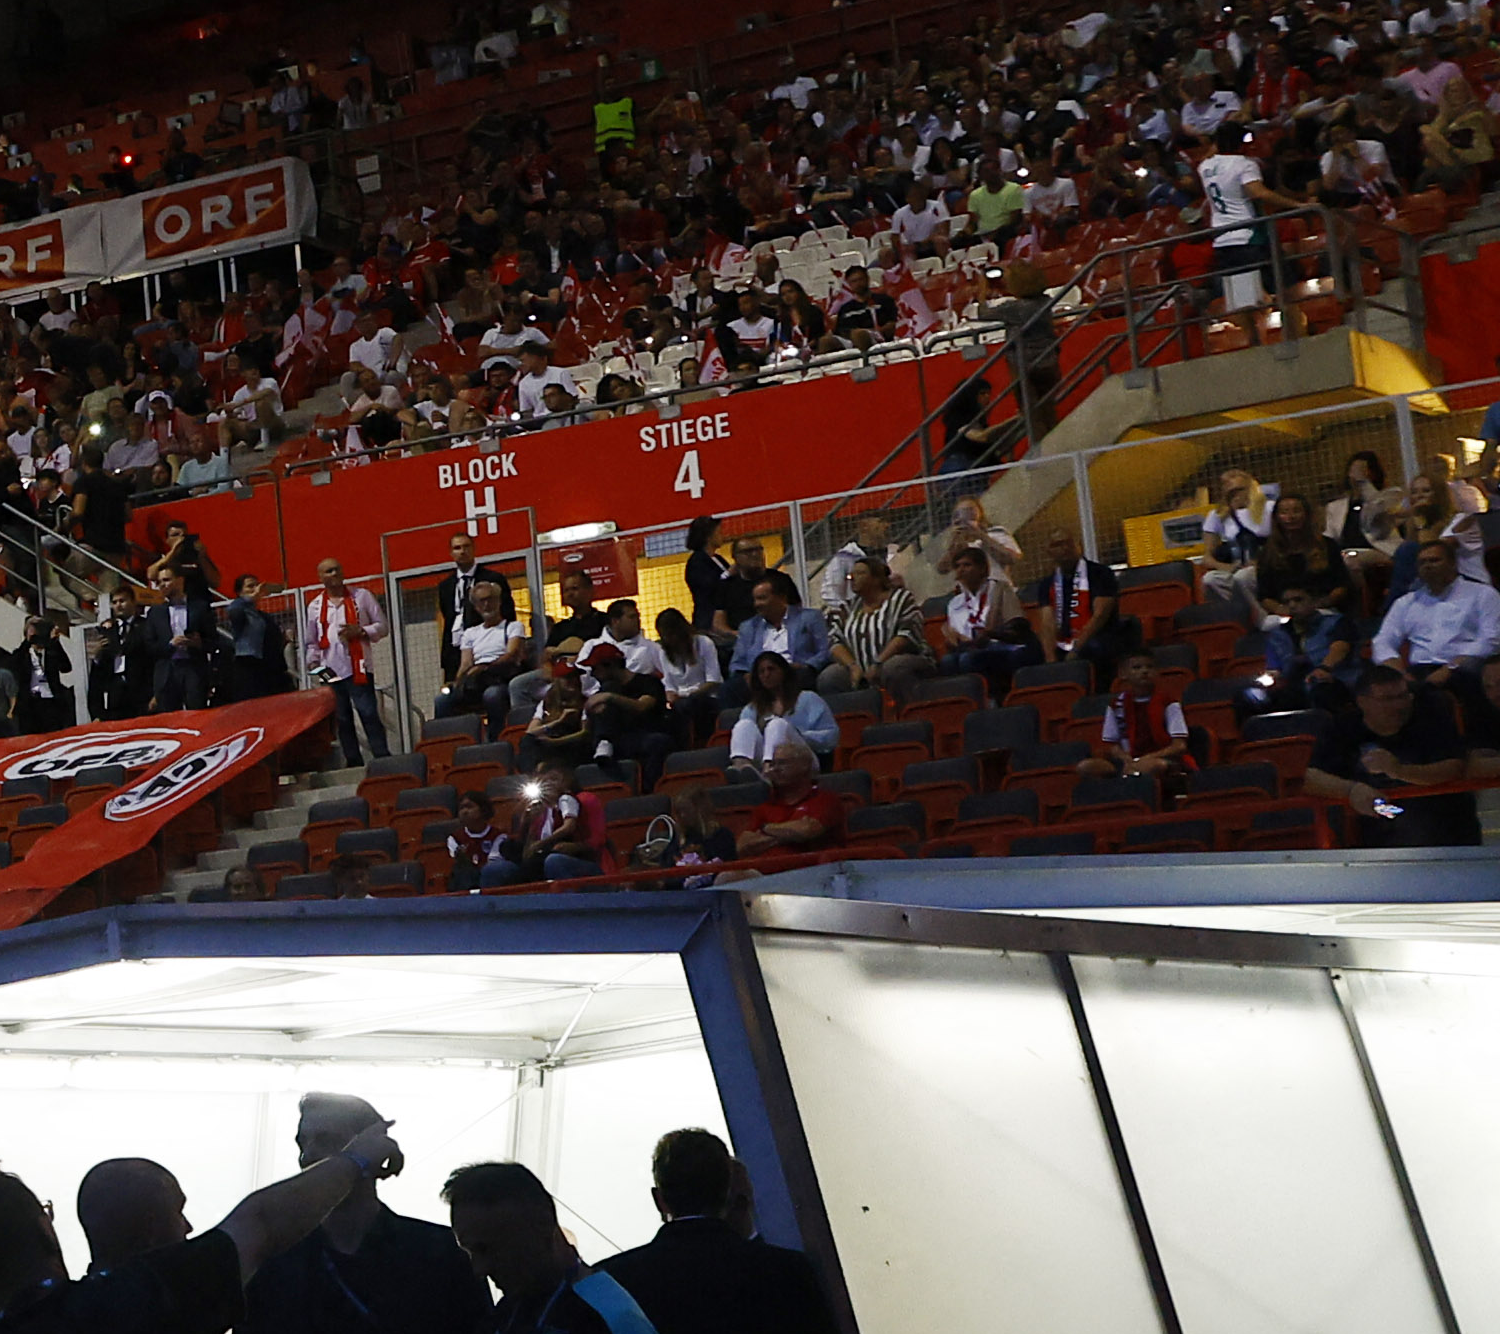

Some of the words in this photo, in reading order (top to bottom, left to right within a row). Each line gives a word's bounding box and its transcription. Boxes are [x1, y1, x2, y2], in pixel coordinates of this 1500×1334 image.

[155, 182, 277, 244] ORF
[639, 411, 731, 452] STIEGE
[438, 451, 518, 489] BLOCK
[674, 449, 706, 499] 4
[464, 486, 498, 537] H
